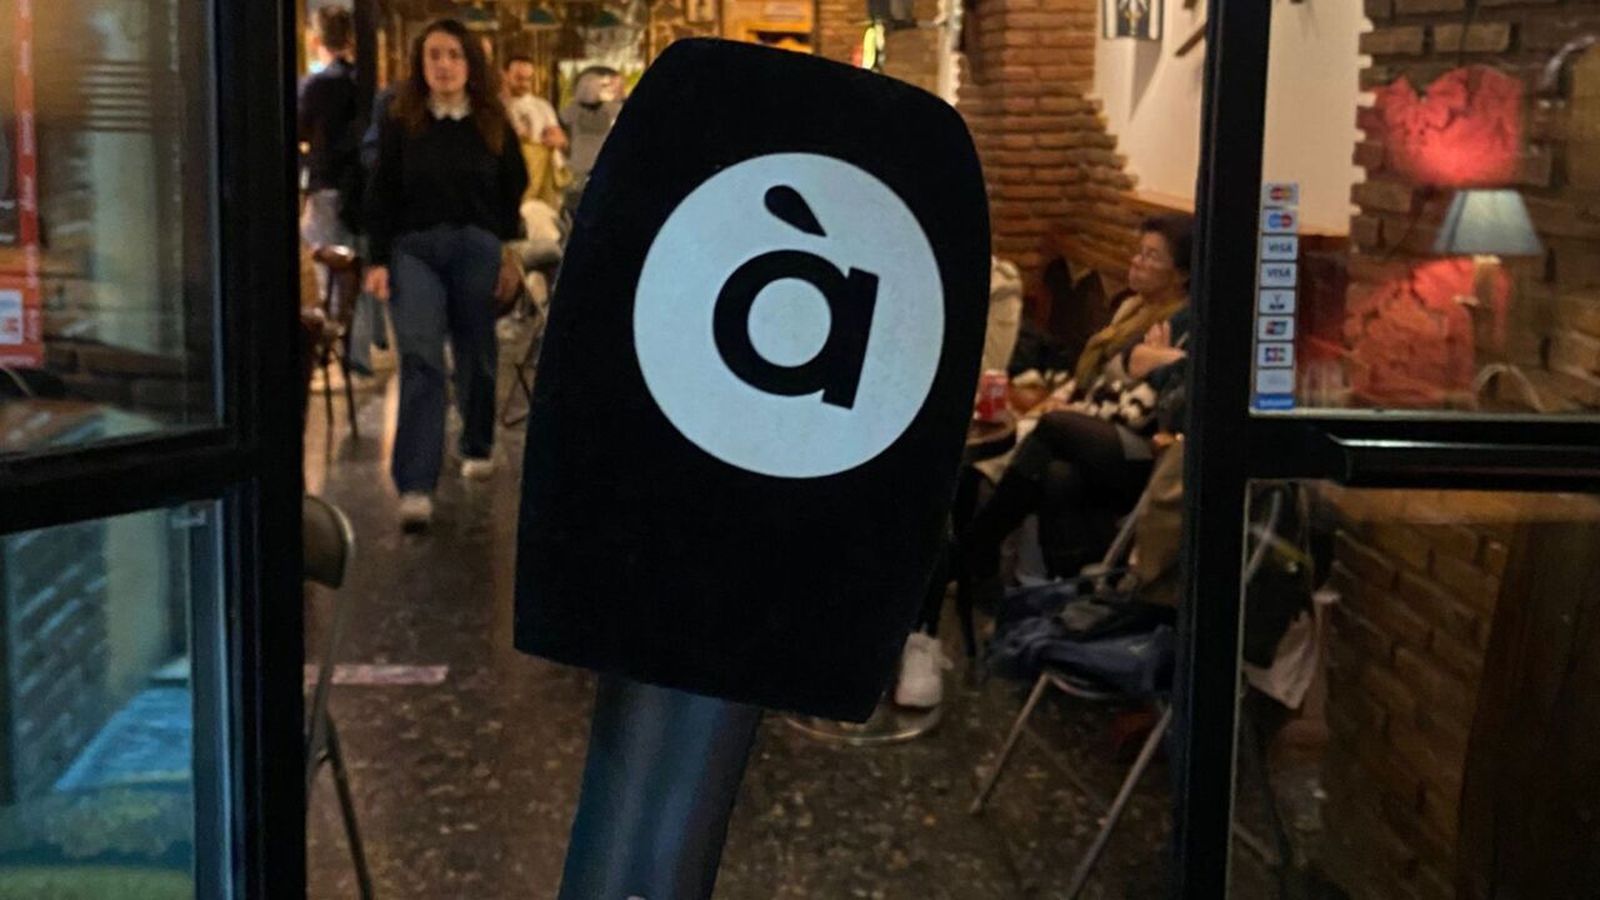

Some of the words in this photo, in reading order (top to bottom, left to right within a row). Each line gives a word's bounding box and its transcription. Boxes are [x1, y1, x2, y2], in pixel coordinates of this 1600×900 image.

[1268, 242, 1292, 253] VISA
[1267, 268, 1290, 277] VISA
[713, 184, 880, 411] à
